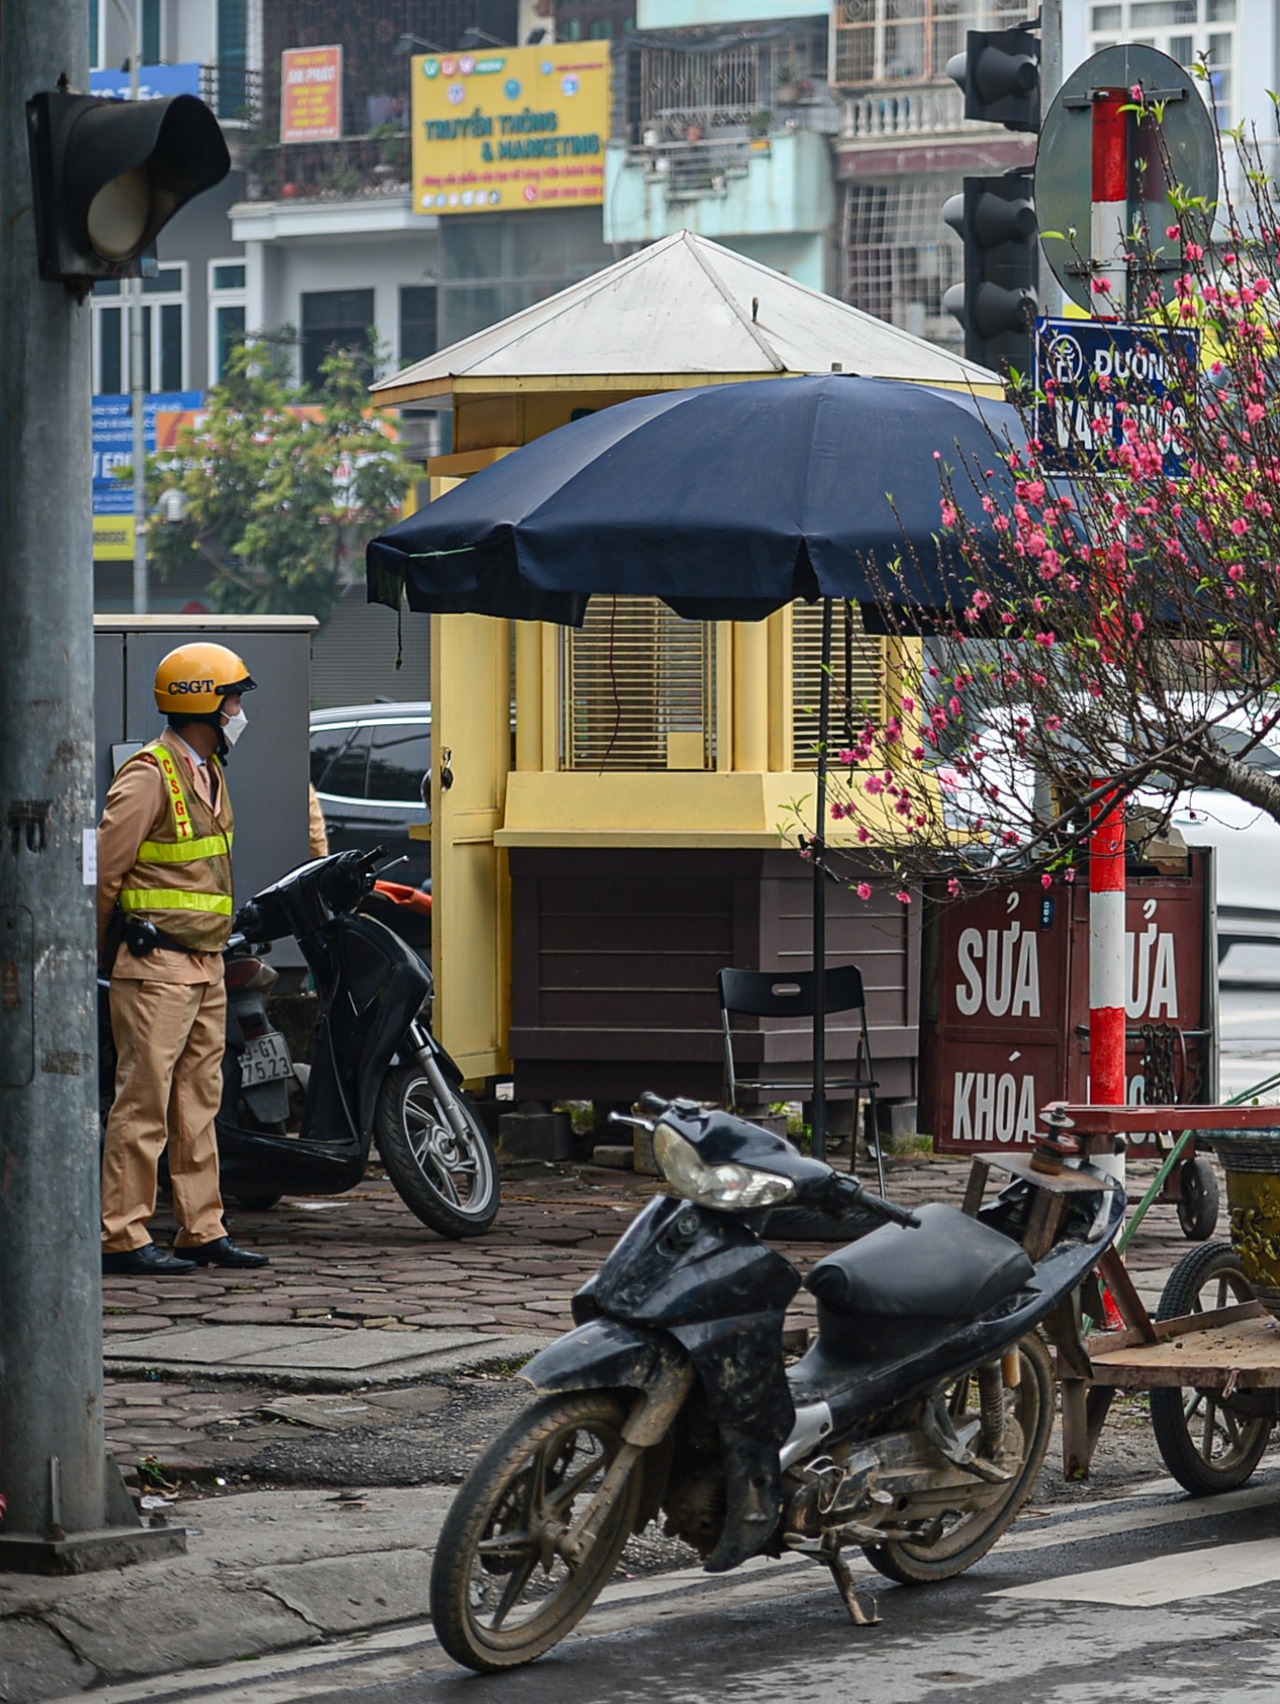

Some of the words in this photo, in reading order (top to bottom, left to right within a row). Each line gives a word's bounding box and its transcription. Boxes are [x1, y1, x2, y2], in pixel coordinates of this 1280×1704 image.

[481, 141, 494, 163] &
[499, 133, 600, 160] MARKETING
[168, 680, 214, 695] CSGT
[955, 891, 1041, 1018] SỬA
[1124, 898, 1179, 1020] ỬA
[952, 1050, 1037, 1144] KHÓA
